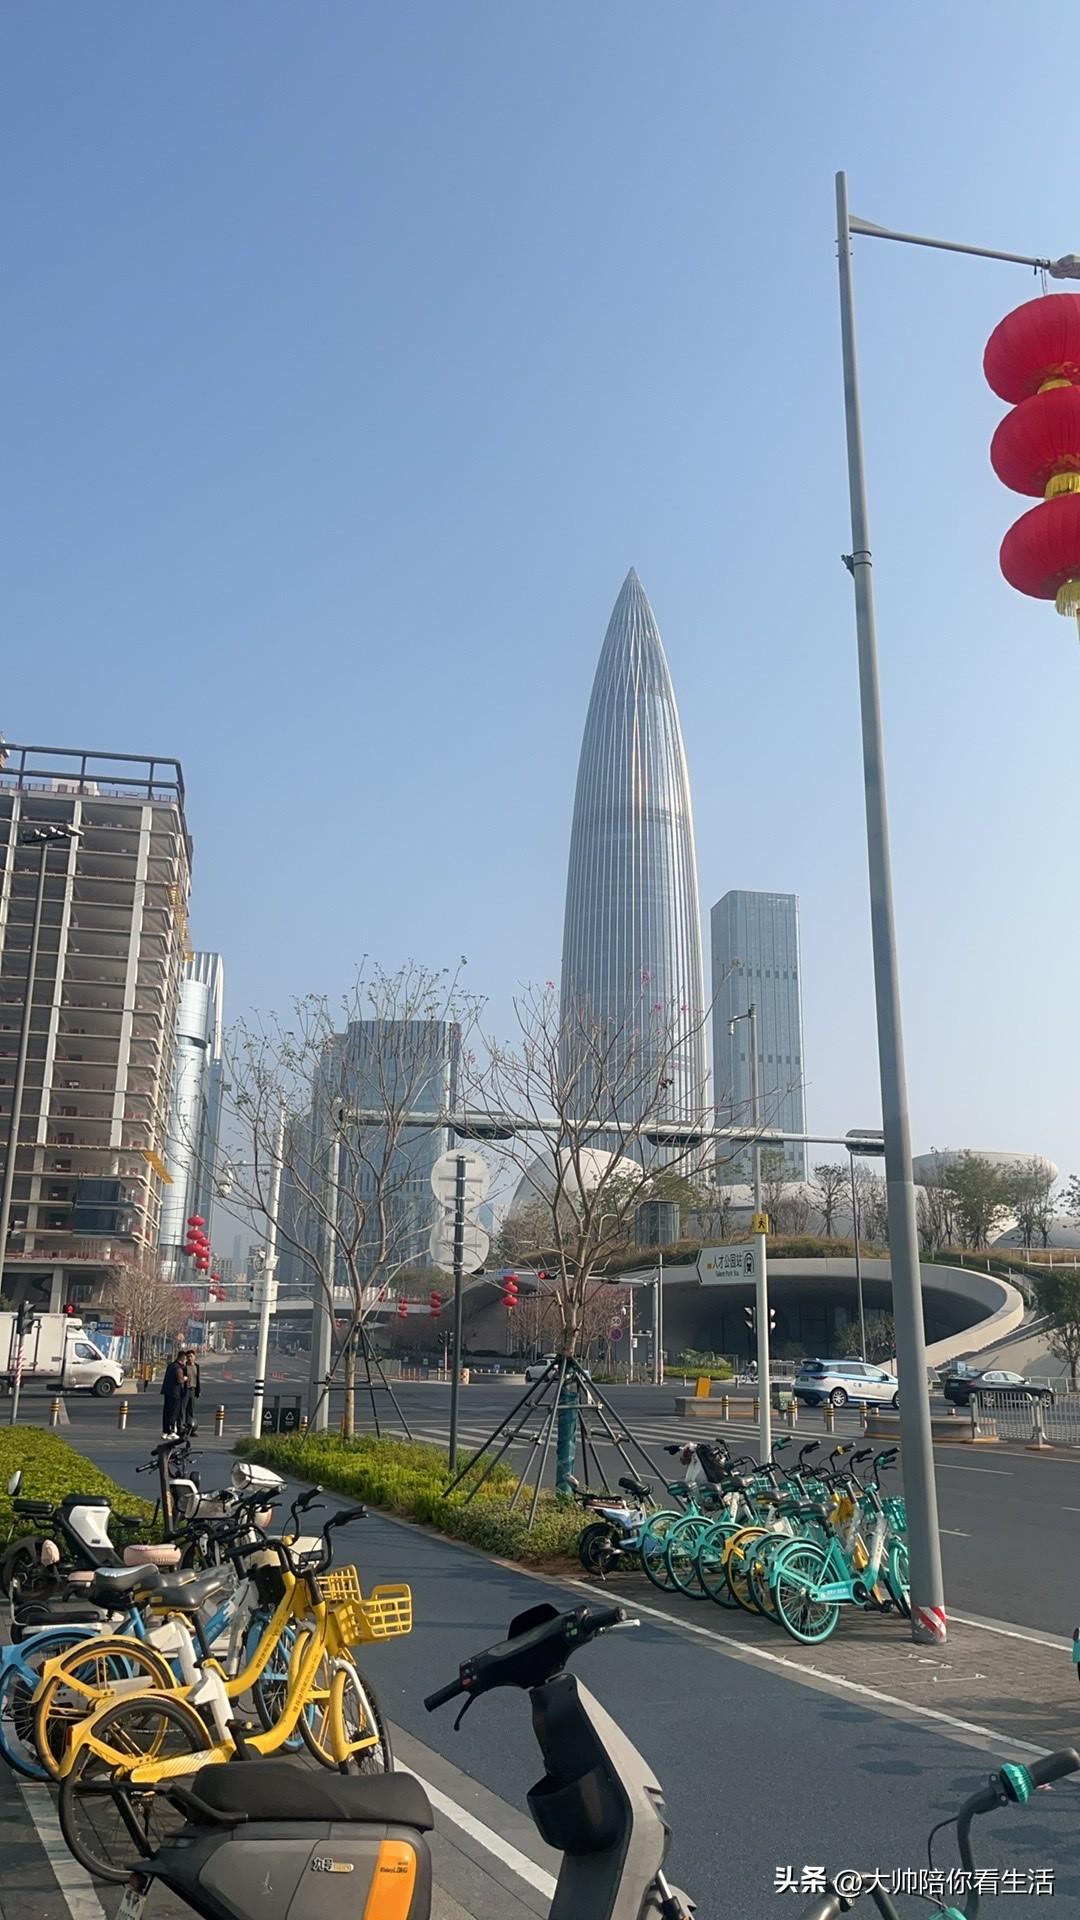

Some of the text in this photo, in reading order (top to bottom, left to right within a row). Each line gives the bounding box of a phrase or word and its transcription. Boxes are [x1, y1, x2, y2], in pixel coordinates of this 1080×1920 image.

[714, 1252, 742, 1268] 人才公园站
[312, 1857, 334, 1872] 九号
